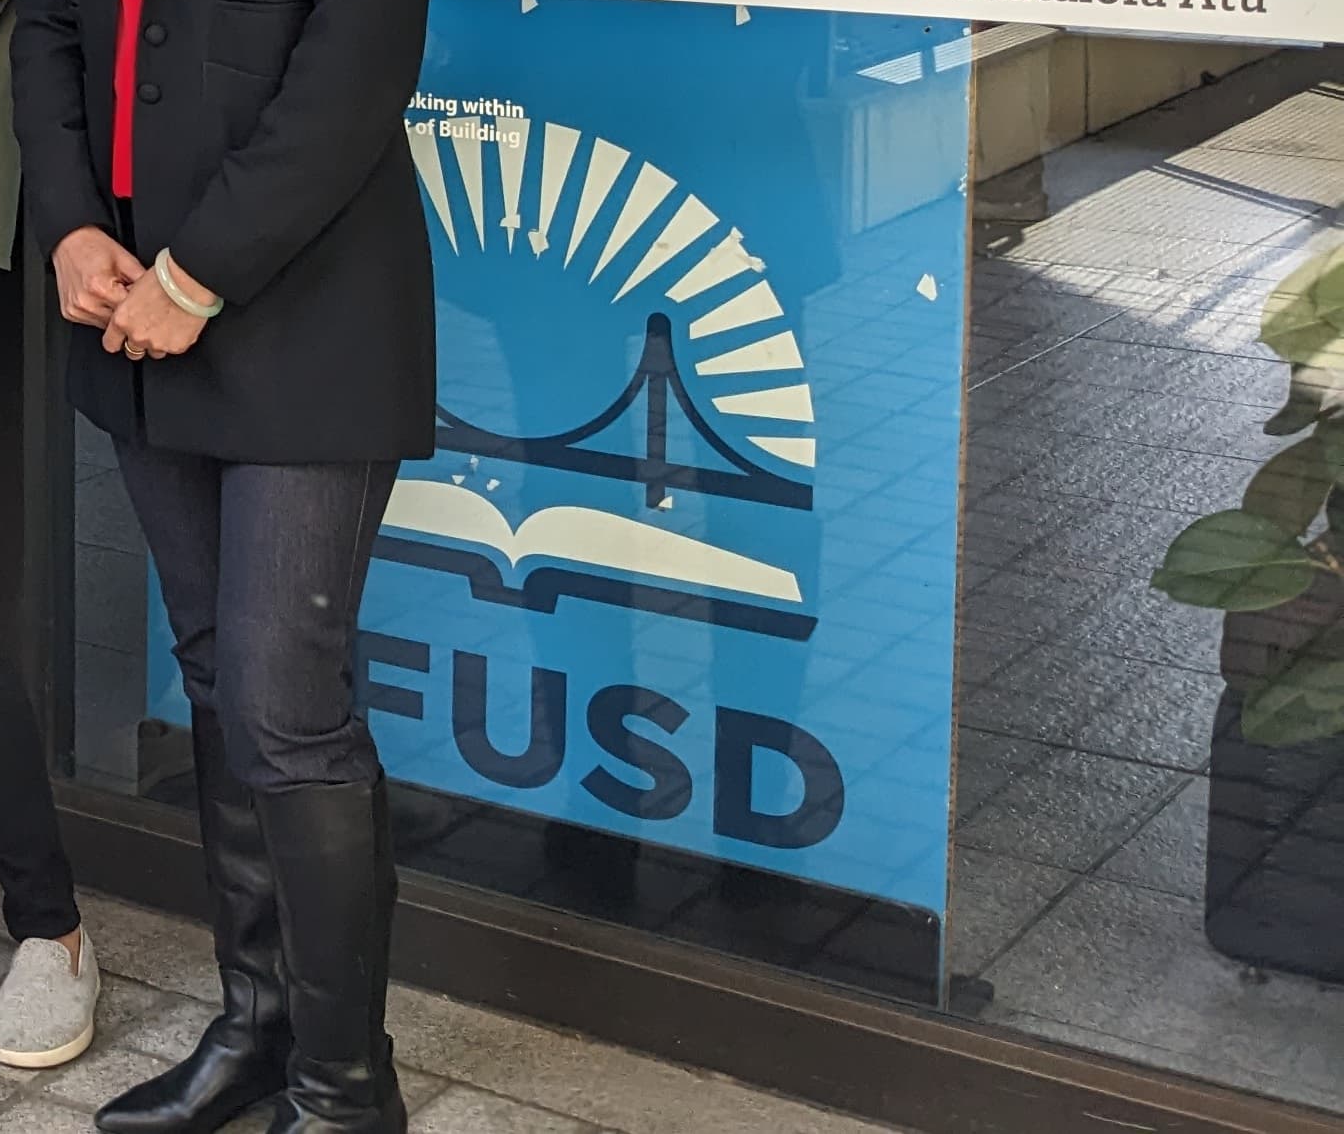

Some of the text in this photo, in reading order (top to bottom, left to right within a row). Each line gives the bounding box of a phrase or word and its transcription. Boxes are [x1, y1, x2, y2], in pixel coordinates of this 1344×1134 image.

[462, 97, 525, 118] within
[415, 118, 435, 136] of
[439, 120, 521, 149] Building
[357, 629, 845, 849] FUSD
